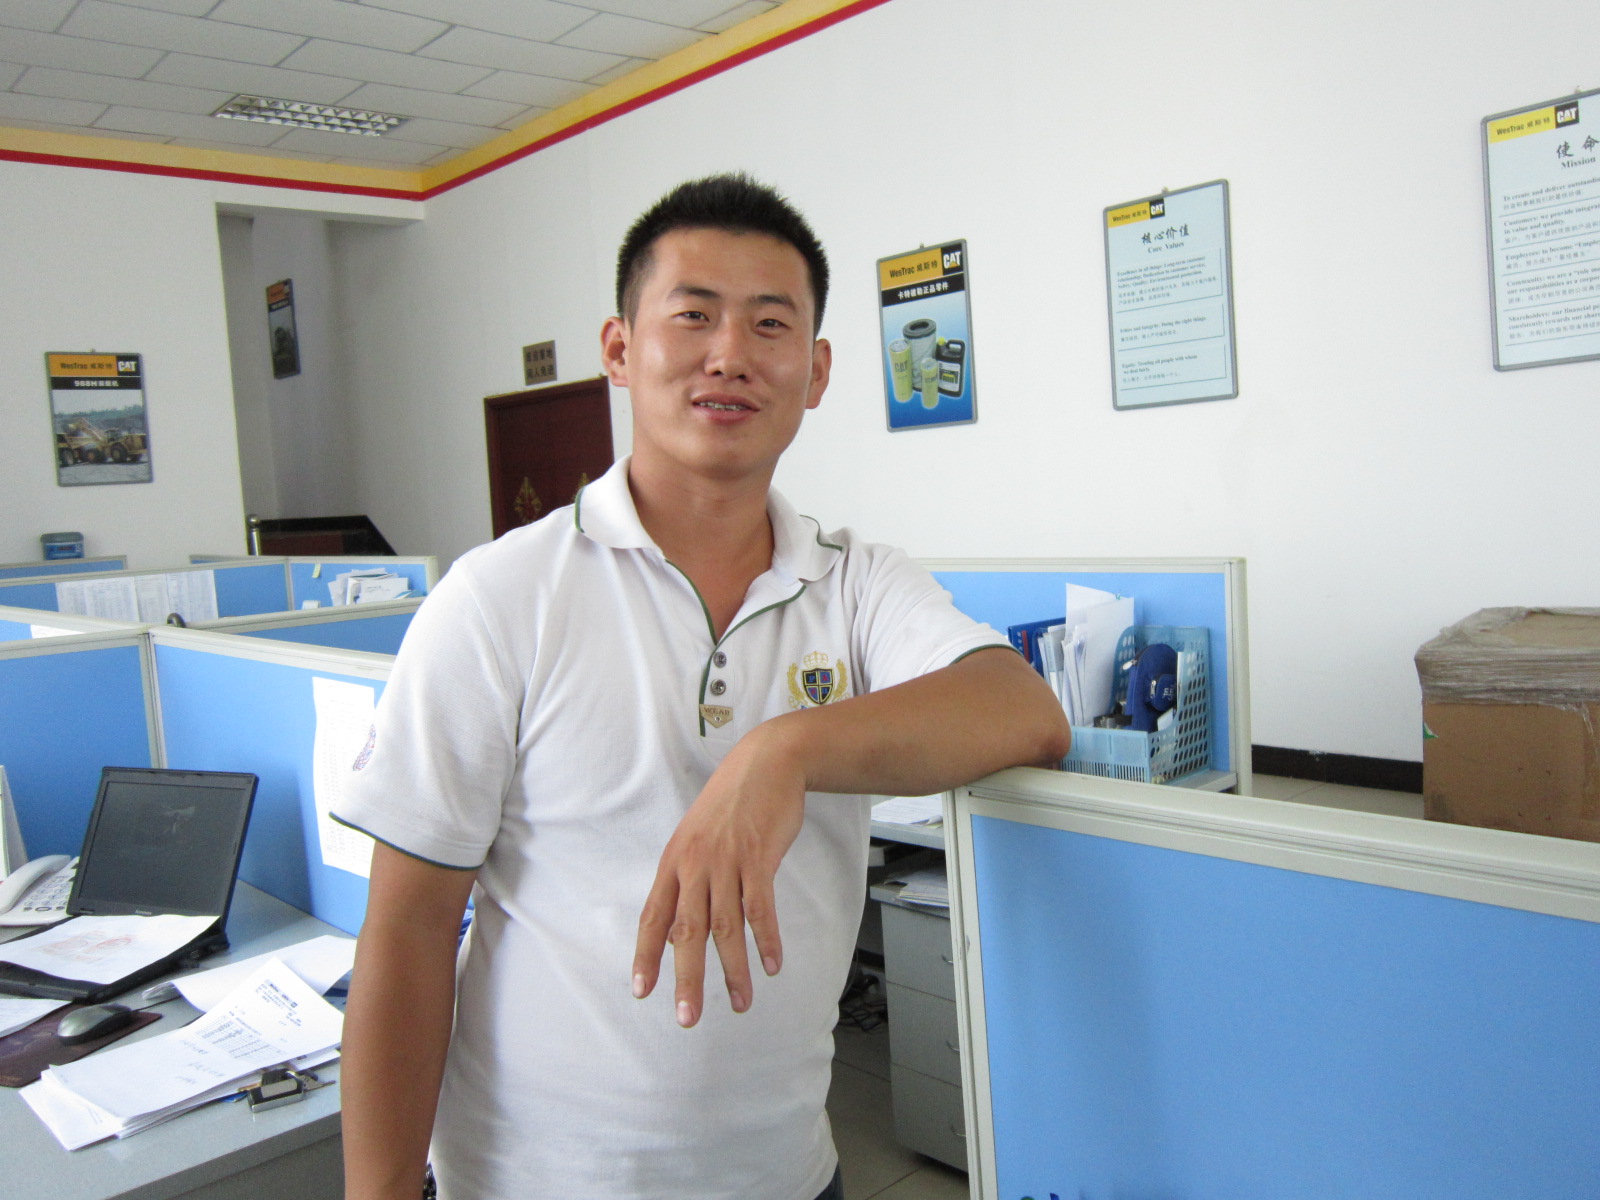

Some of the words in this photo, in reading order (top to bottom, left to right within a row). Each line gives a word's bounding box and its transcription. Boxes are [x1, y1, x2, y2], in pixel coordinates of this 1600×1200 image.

[1556, 108, 1577, 123] CAT
[1496, 124, 1524, 136] WesTrac
[1556, 135, 1599, 159] 使命
[1561, 157, 1596, 169] Mission
[1150, 204, 1164, 216] CAT
[1148, 245, 1162, 254] Core
[1165, 241, 1184, 250] Values
[944, 251, 961, 268] CAT
[889, 267, 914, 278] WesTrac
[118, 361, 136, 372] CAT
